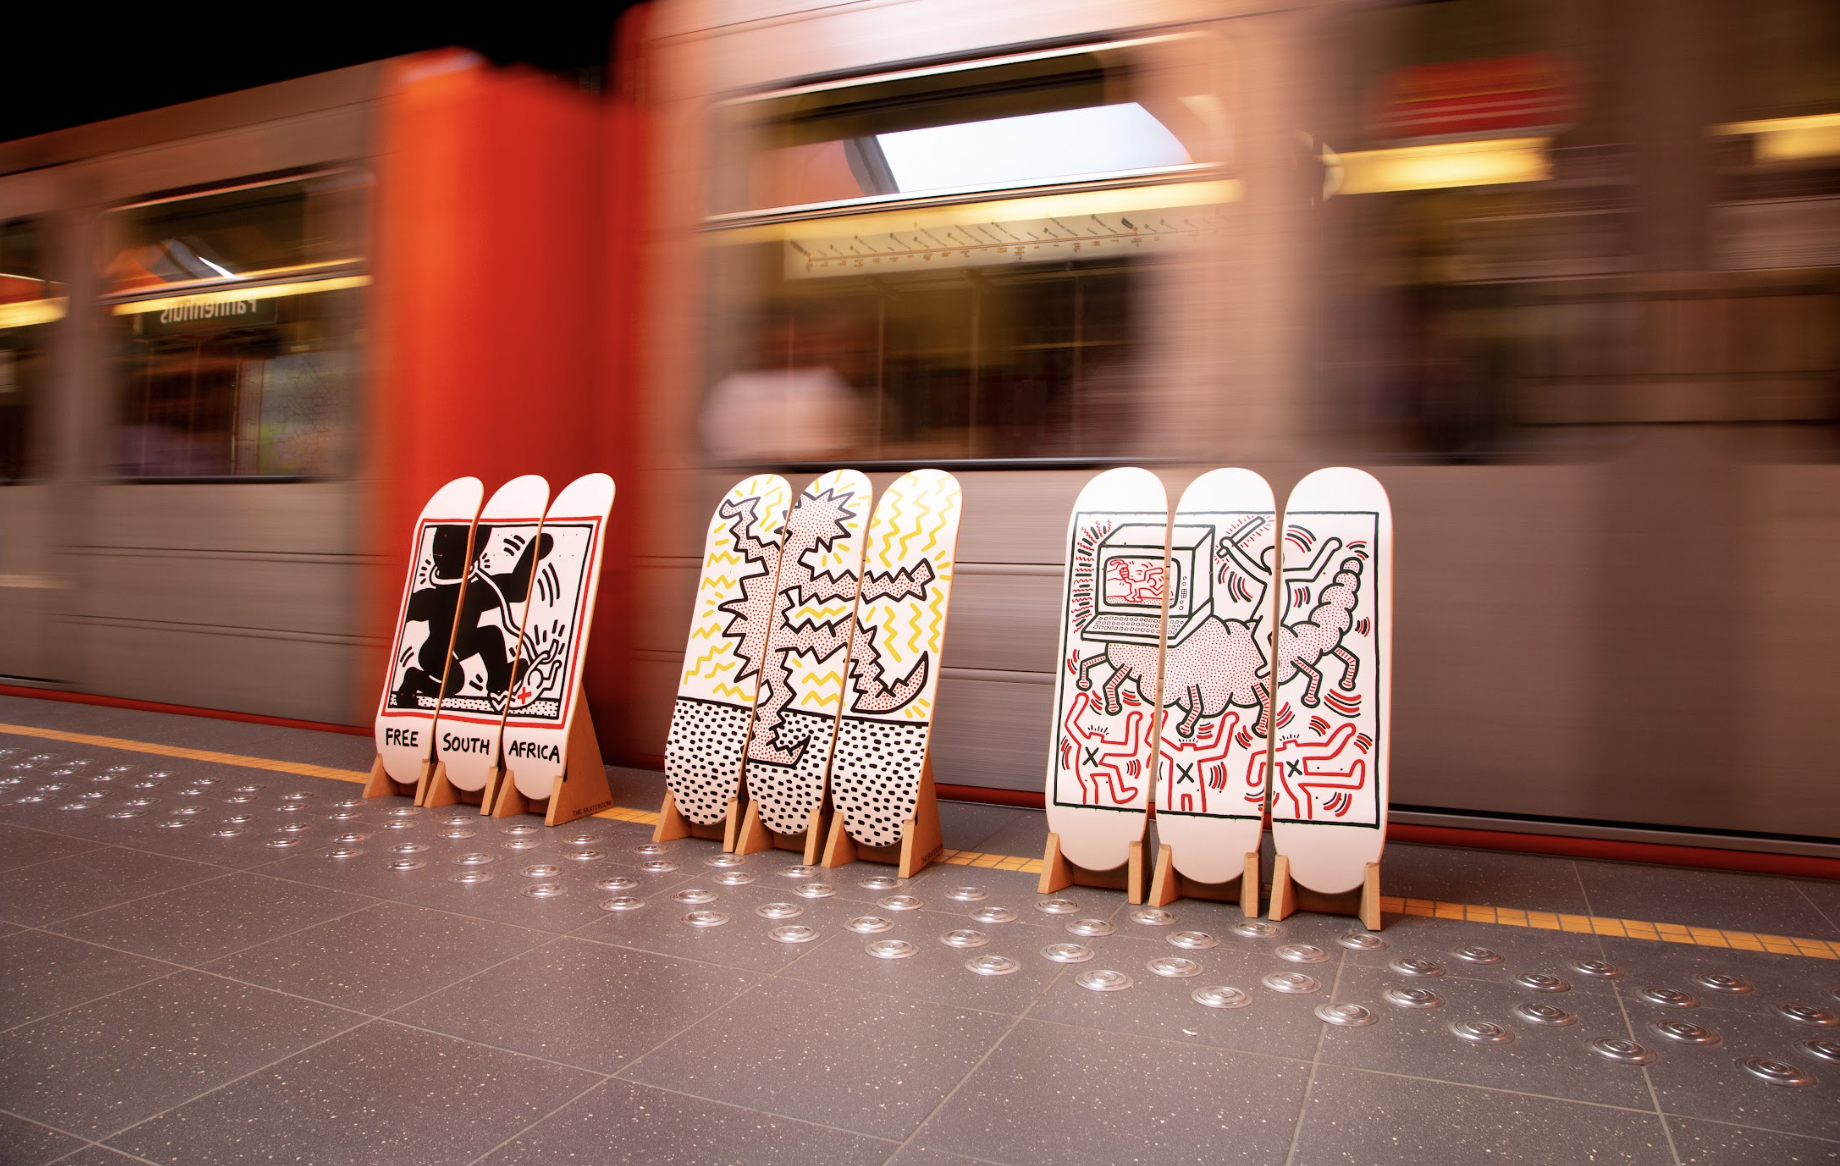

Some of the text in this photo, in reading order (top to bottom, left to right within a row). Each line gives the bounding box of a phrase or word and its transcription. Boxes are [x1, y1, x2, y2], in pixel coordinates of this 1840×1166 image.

[385, 728, 560, 764] FREE SOUTH AFRICA
[572, 808, 582, 816] THE
